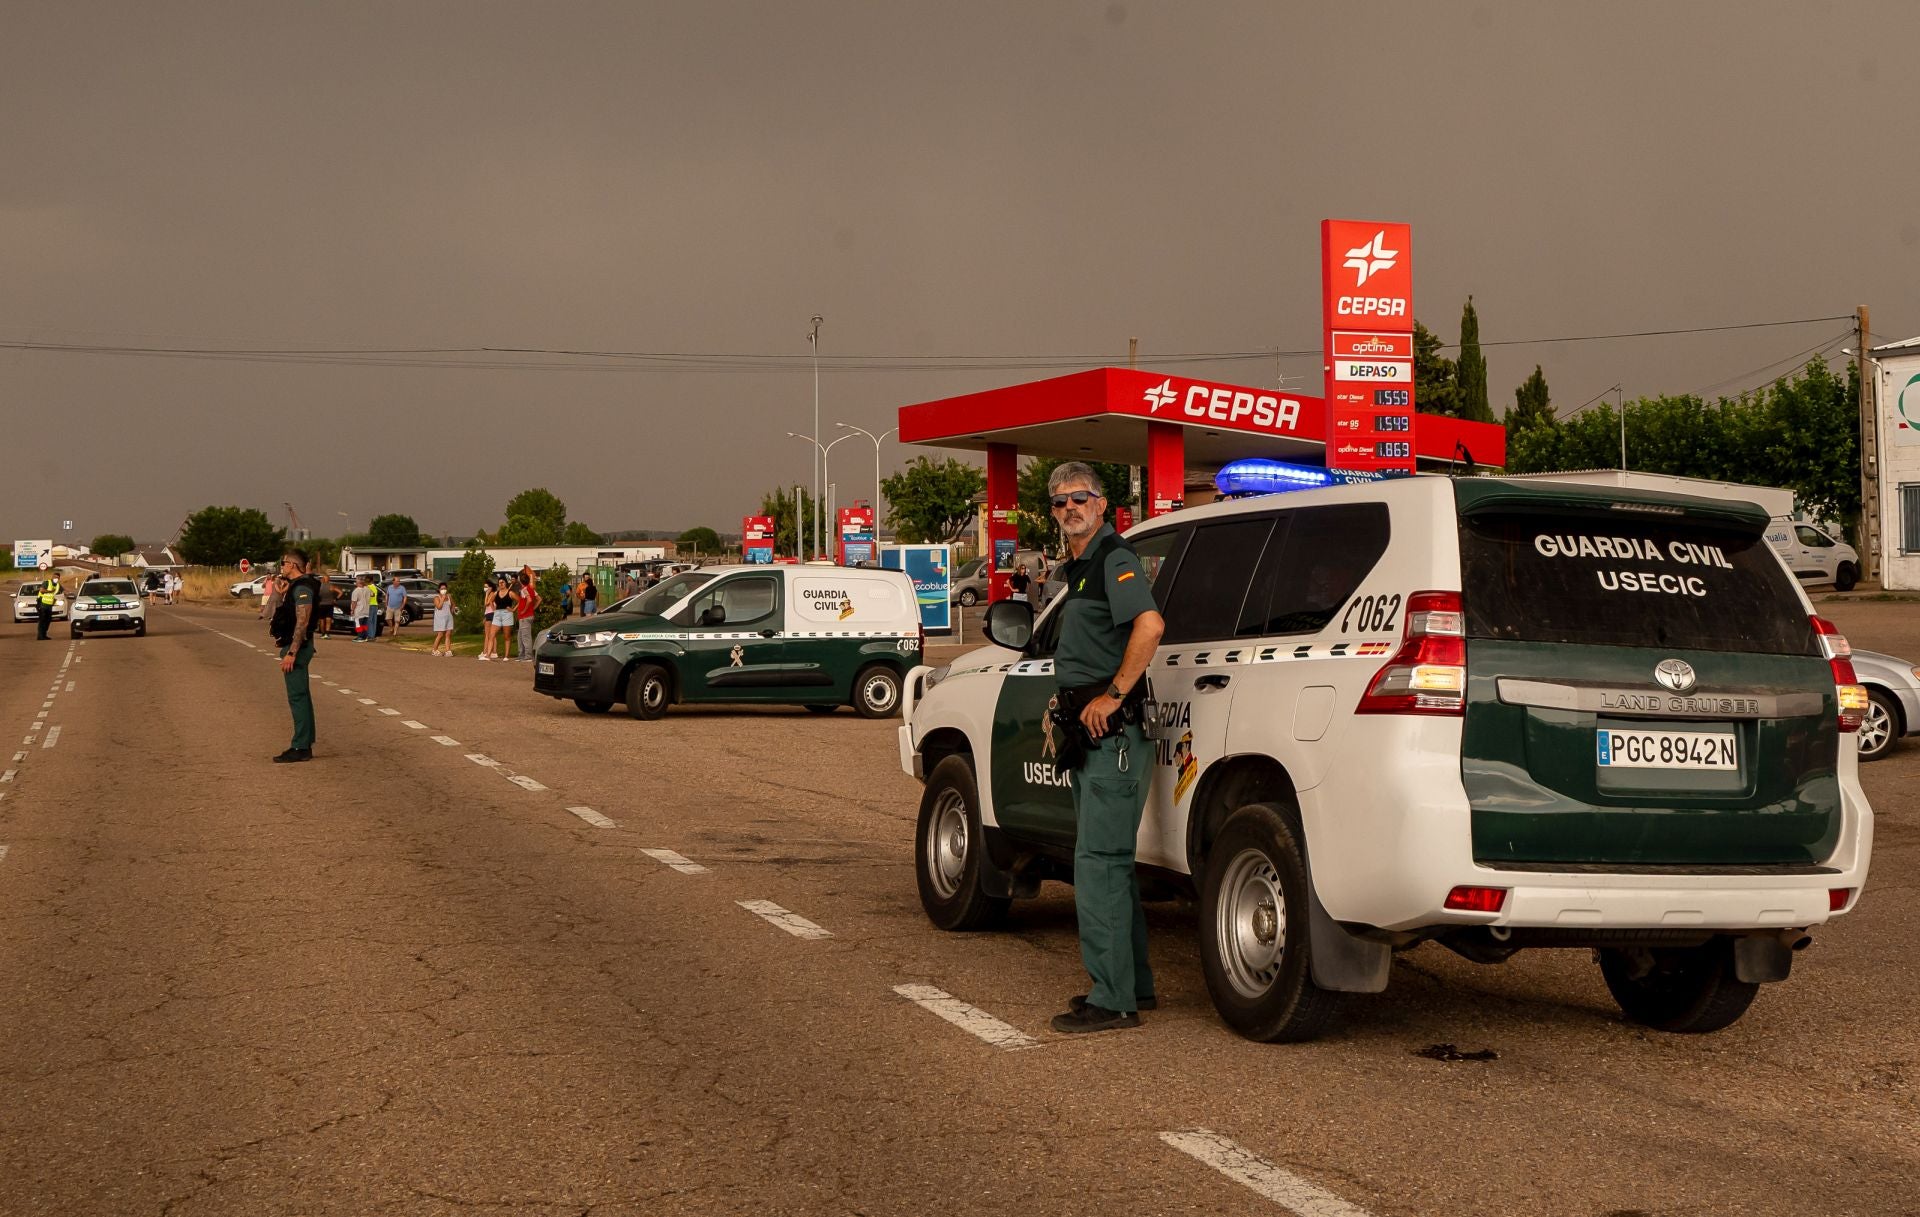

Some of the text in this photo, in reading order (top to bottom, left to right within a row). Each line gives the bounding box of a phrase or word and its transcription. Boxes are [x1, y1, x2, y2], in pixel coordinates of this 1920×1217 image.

[1337, 296, 1406, 316] CEPSA
[1352, 343, 1394, 355] optima
[1350, 365, 1397, 378] DEPASO
[1379, 390, 1409, 405] 1.559
[1184, 385, 1301, 430] CEPSA
[1349, 419, 1360, 428] 95
[1379, 416, 1409, 431] 1.549
[1330, 468, 1383, 479] GUARDIA
[1766, 532, 1788, 542] ualia
[1534, 534, 1734, 569] GUARDIA CIVIL
[914, 581, 949, 591] ecoblue
[1596, 571, 1707, 597] USECIC
[803, 589, 848, 599] GUARDIA
[814, 601, 839, 610] CIVIL
[1357, 593, 1402, 632] 062
[903, 639, 919, 651] 062
[1600, 692, 1760, 714] LAND CRUISER
[1601, 751, 1608, 760] E
